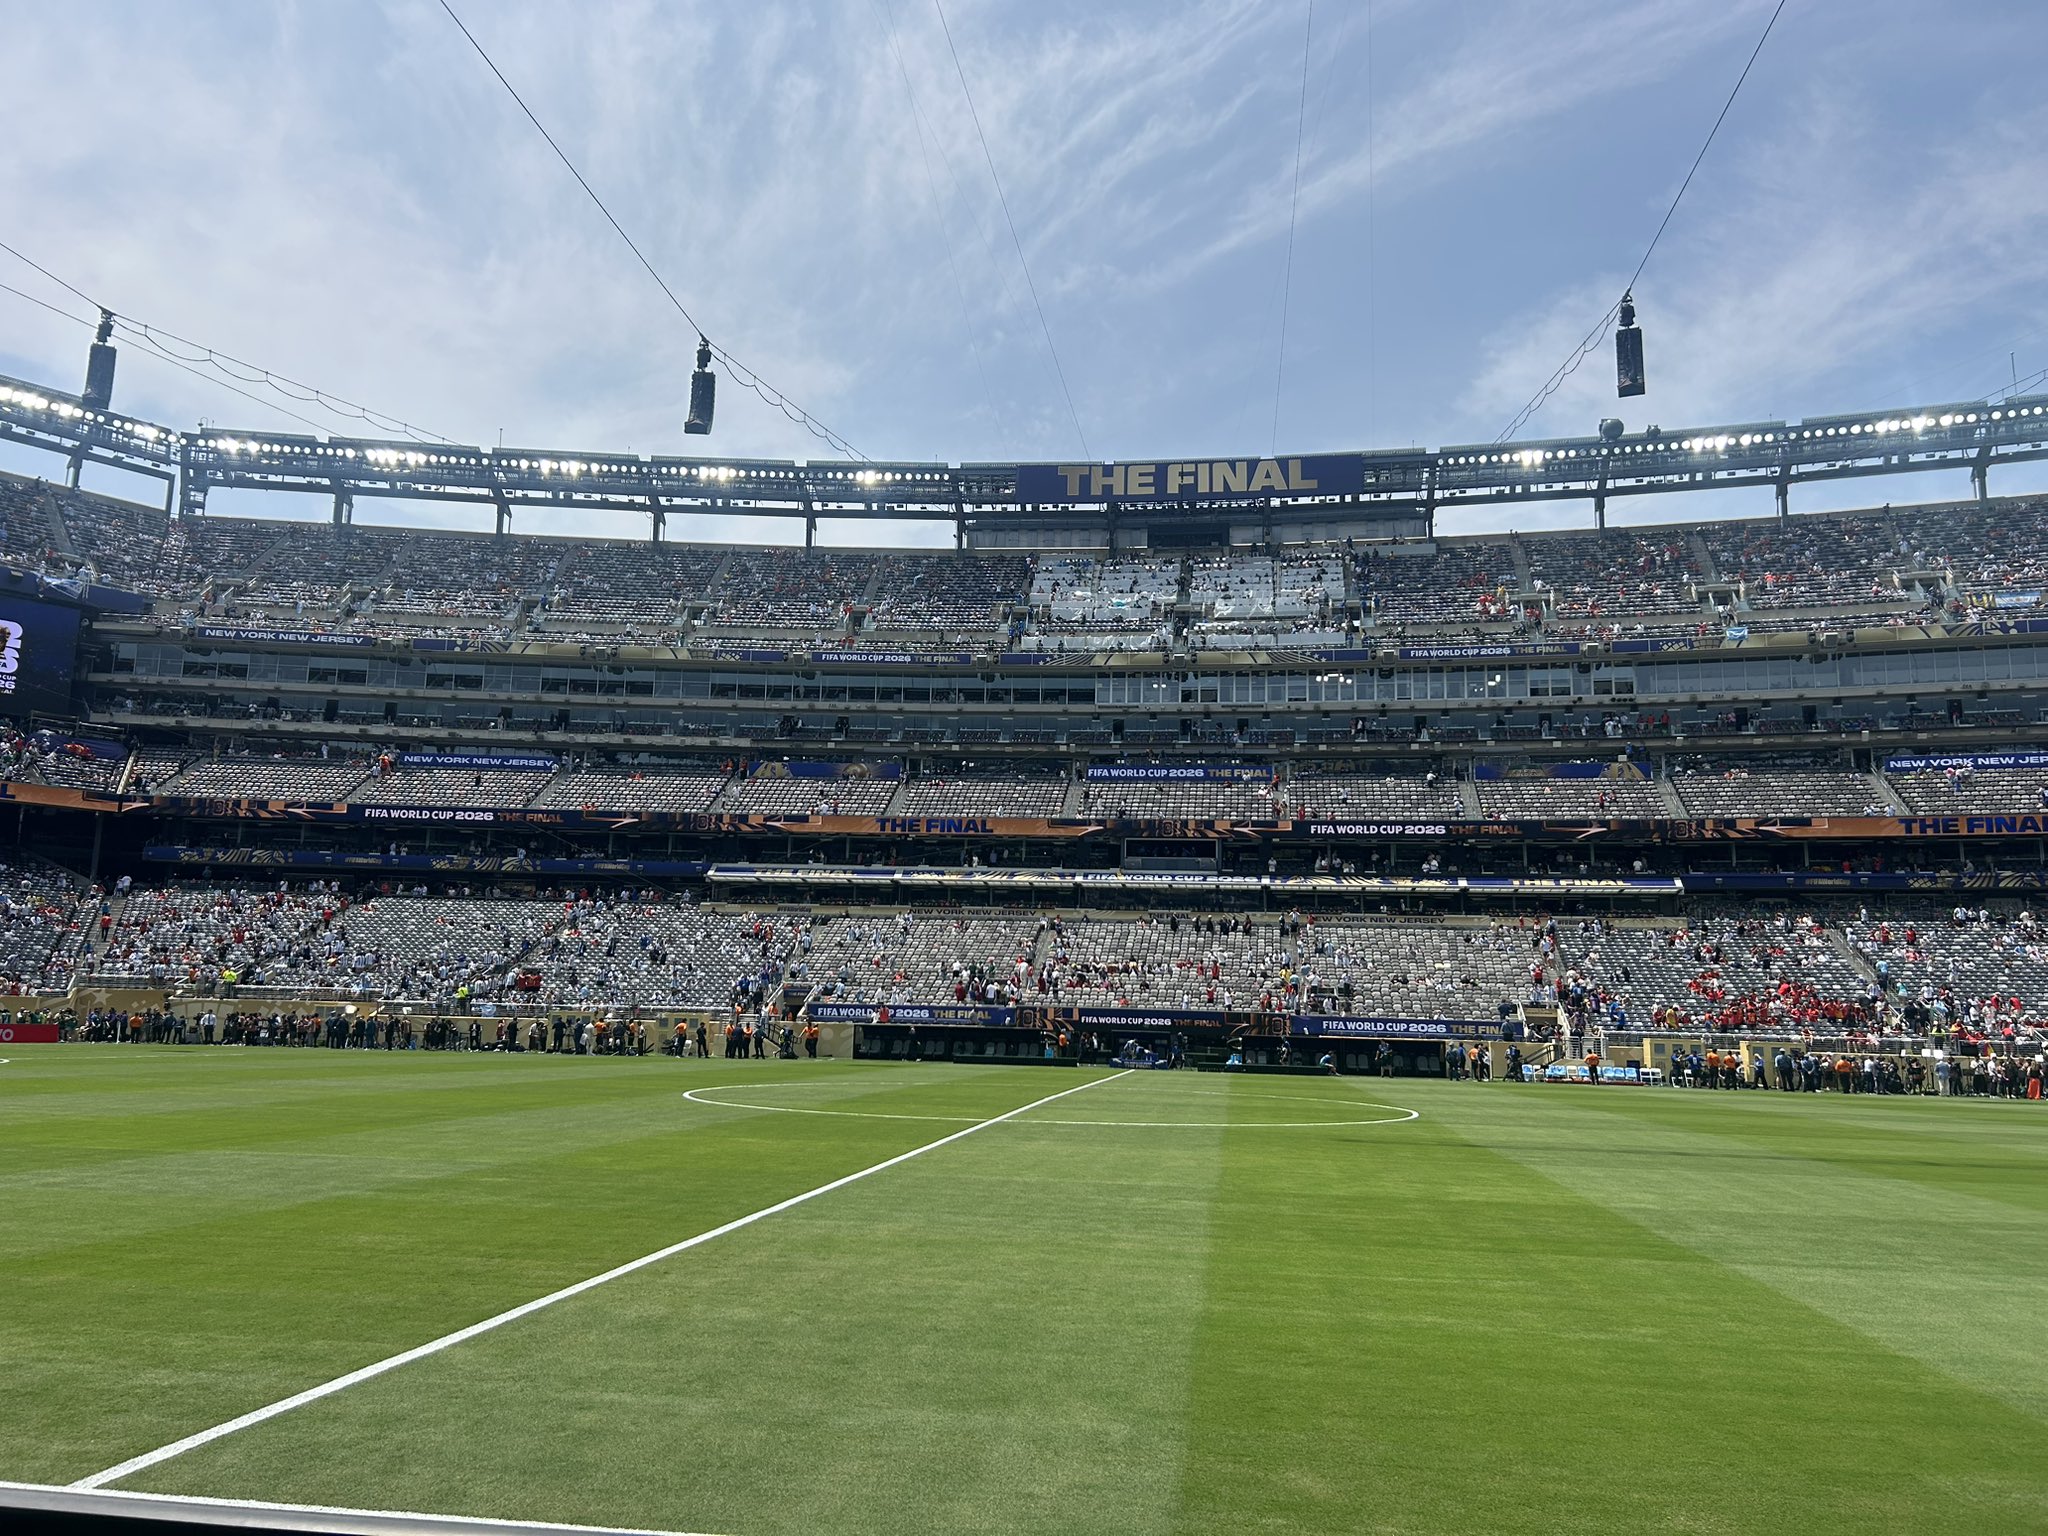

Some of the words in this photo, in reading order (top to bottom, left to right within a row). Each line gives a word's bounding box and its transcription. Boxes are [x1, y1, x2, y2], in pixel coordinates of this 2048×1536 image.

[1057, 465, 1156, 496] THE
[1166, 459, 1318, 494] FINAL
[205, 629, 236, 637] NEW
[240, 631, 276, 640] YORK
[279, 633, 308, 641] NEW
[312, 635, 364, 644] JERSEY
[1462, 648, 1479, 656] CUP
[1514, 646, 1534, 654] THE
[868, 654, 884, 662] CUP
[436, 756, 470, 764] YORK
[504, 758, 553, 767] JERSEY
[1890, 760, 1926, 768] NEW
[1930, 758, 1974, 766] YORK
[1978, 756, 2014, 764] NEW
[1088, 768, 1109, 777] FIFA
[1110, 768, 1146, 777] WORLD
[1148, 769, 1168, 777] CUP
[1169, 768, 1204, 777] 2026
[1208, 768, 1232, 777] THE
[365, 808, 388, 818] FIFA
[390, 810, 430, 819] WORLD
[432, 810, 454, 820] CUP
[455, 812, 494, 821] 2026
[498, 812, 522, 822] THE
[526, 813, 564, 823] FINAL
[876, 818, 920, 832] THE
[926, 818, 994, 833] FINAL
[1310, 825, 1334, 834] FIFA
[1336, 826, 1378, 834] WORLD
[1380, 826, 1403, 834] CUP
[1404, 826, 1446, 834] 2026
[1450, 826, 1475, 834] THE
[1480, 825, 1522, 834] FINAL
[1898, 818, 1960, 834] THE
[818, 1008, 838, 1016] FIFA
[840, 1008, 874, 1017] WORLD
[896, 1009, 929, 1018] 2026
[932, 1010, 956, 1018] THE
[1098, 1016, 1126, 1024] WORLD
[1144, 1018, 1172, 1026] 2026
[1174, 1018, 1192, 1026] THE
[1323, 1020, 1345, 1030] FIFA
[1346, 1022, 1384, 1031] WORLD
[1386, 1022, 1408, 1032] CUP
[1408, 1024, 1446, 1032] 2026
[1452, 1025, 1476, 1034] THE
[1478, 1026, 1500, 1034] FIN
